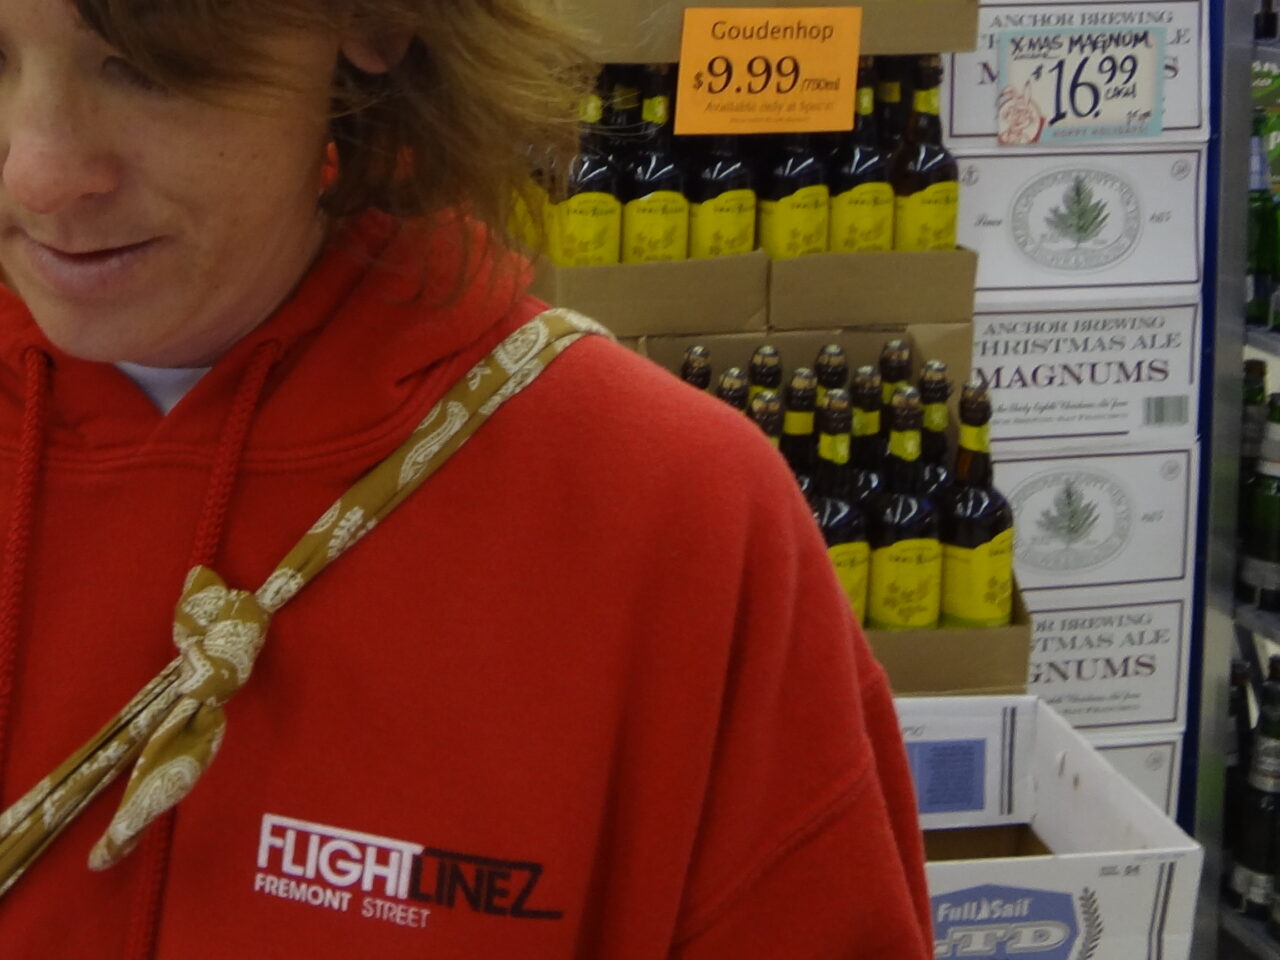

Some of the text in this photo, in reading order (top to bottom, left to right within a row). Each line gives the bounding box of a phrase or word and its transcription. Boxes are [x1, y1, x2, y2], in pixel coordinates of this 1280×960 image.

[711, 20, 835, 44] Goudenhop
[983, 316, 1166, 336] ANCHOR BREWING
[1130, 331, 1183, 350] ALE
[974, 358, 1170, 390] MAGNUMS
[1119, 628, 1171, 649] ALE
[254, 872, 431, 928] FREMONT STREET
[937, 897, 1033, 922] Full Sail
[934, 920, 1070, 957] TD
